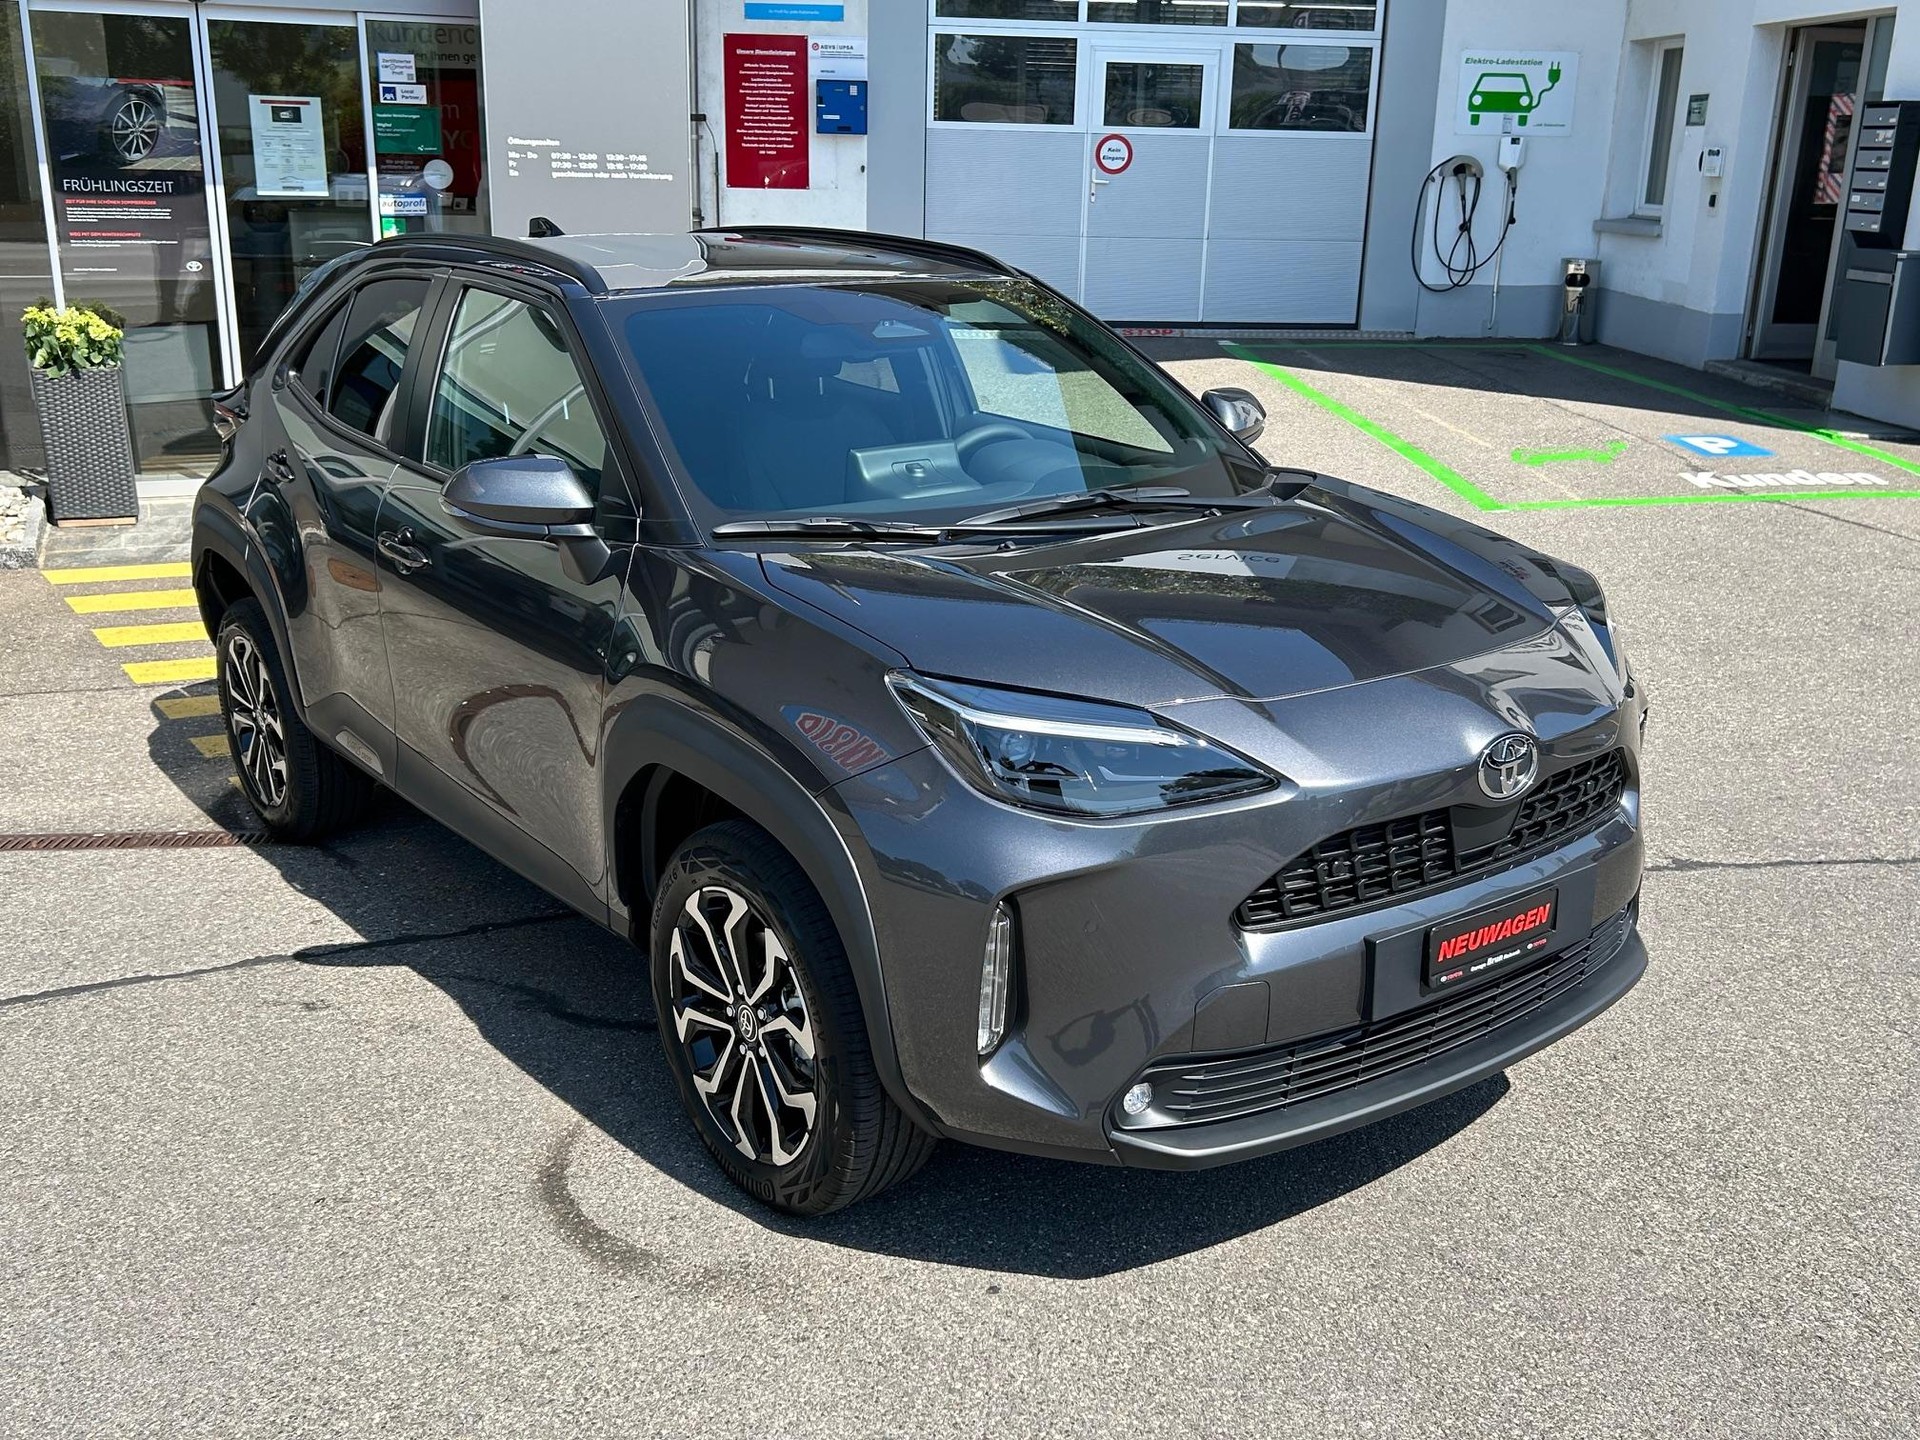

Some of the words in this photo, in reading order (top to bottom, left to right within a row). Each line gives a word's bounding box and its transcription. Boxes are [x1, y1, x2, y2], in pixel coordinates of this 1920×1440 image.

[1464, 57, 1543, 66] Elektro-Ladestation
[63, 176, 175, 194] FRÜHLINGSZEIT
[382, 198, 426, 208] autoprofi
[1680, 436, 1738, 454] P
[1677, 469, 1889, 488] Kunden
[1437, 902, 1551, 962] NEUWAGEN
